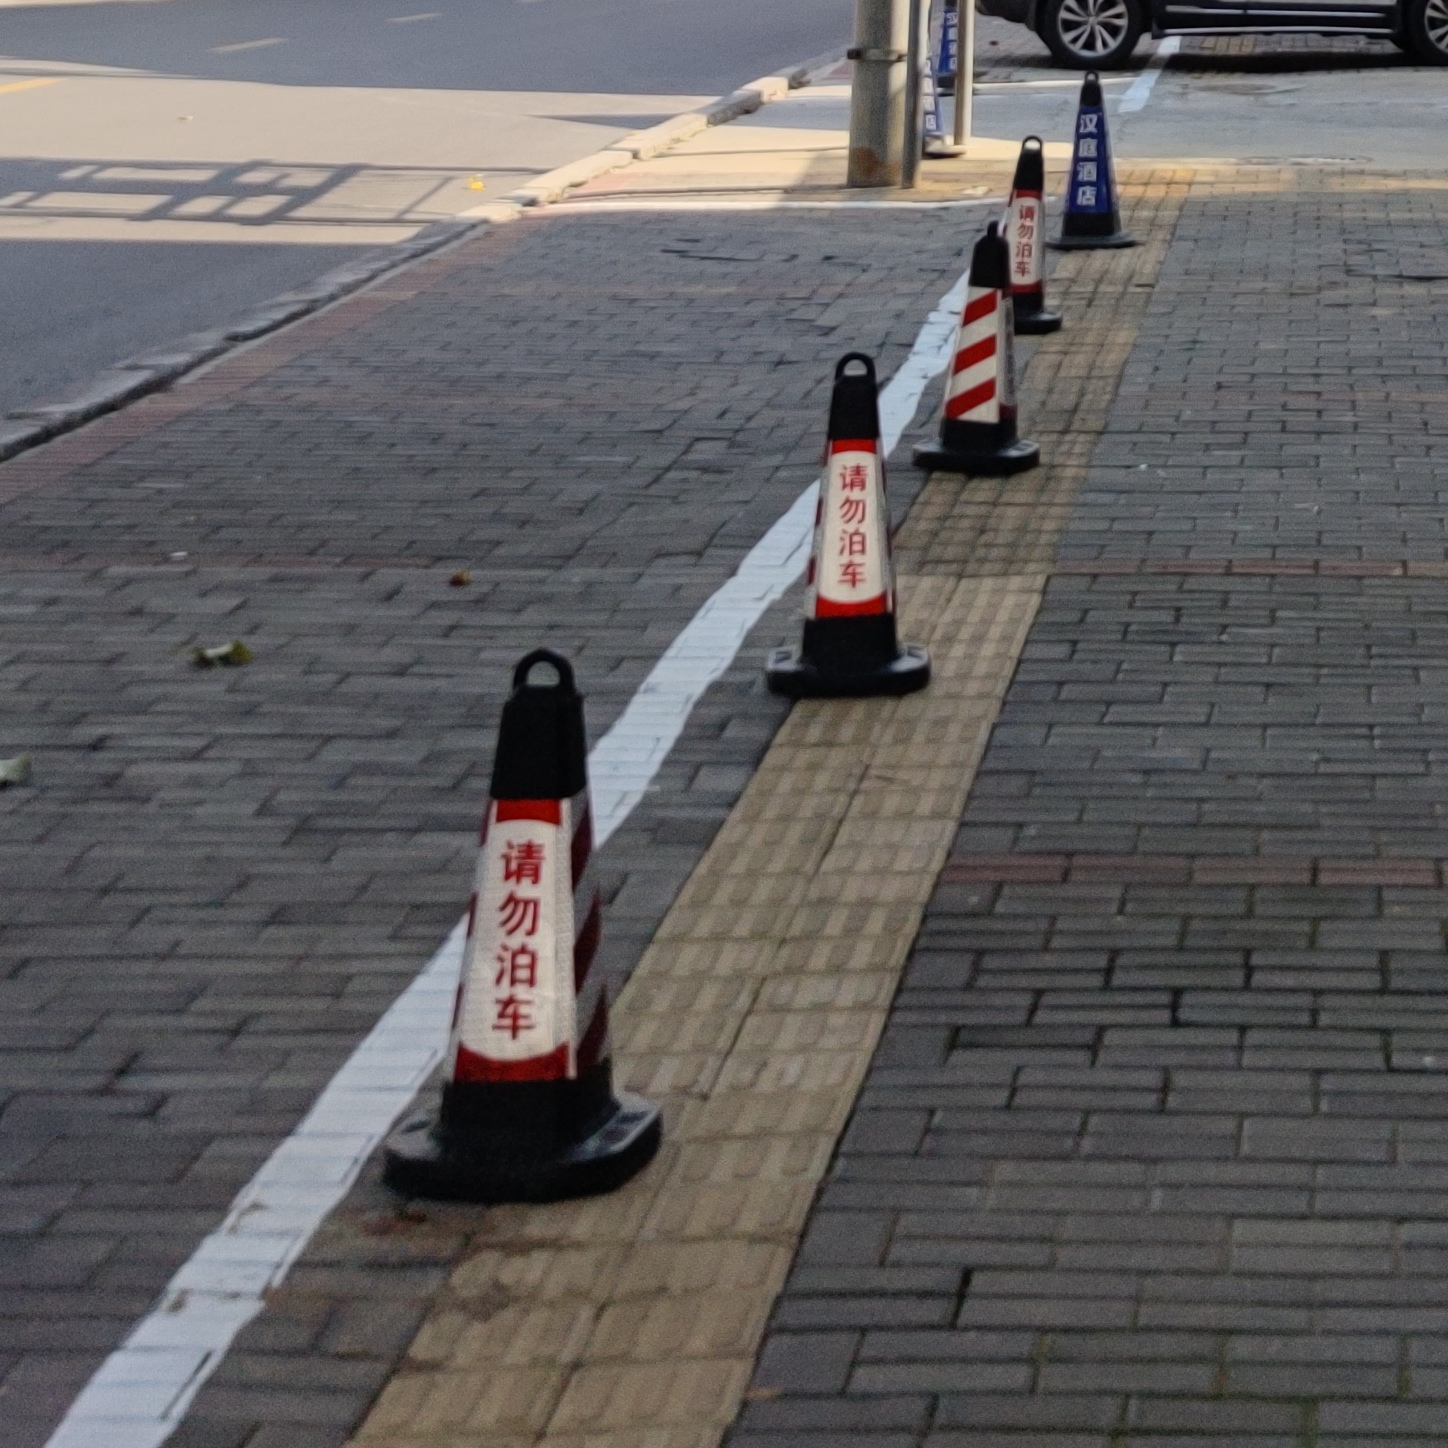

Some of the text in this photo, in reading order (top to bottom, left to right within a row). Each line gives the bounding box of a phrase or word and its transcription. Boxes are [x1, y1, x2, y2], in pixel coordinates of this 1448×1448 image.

[1076, 113, 1099, 207] 汉庭酒店
[1014, 204, 1035, 278] 请勿泊车
[838, 463, 870, 589] 请勿泊车
[492, 840, 547, 1041] 请勿泊车
